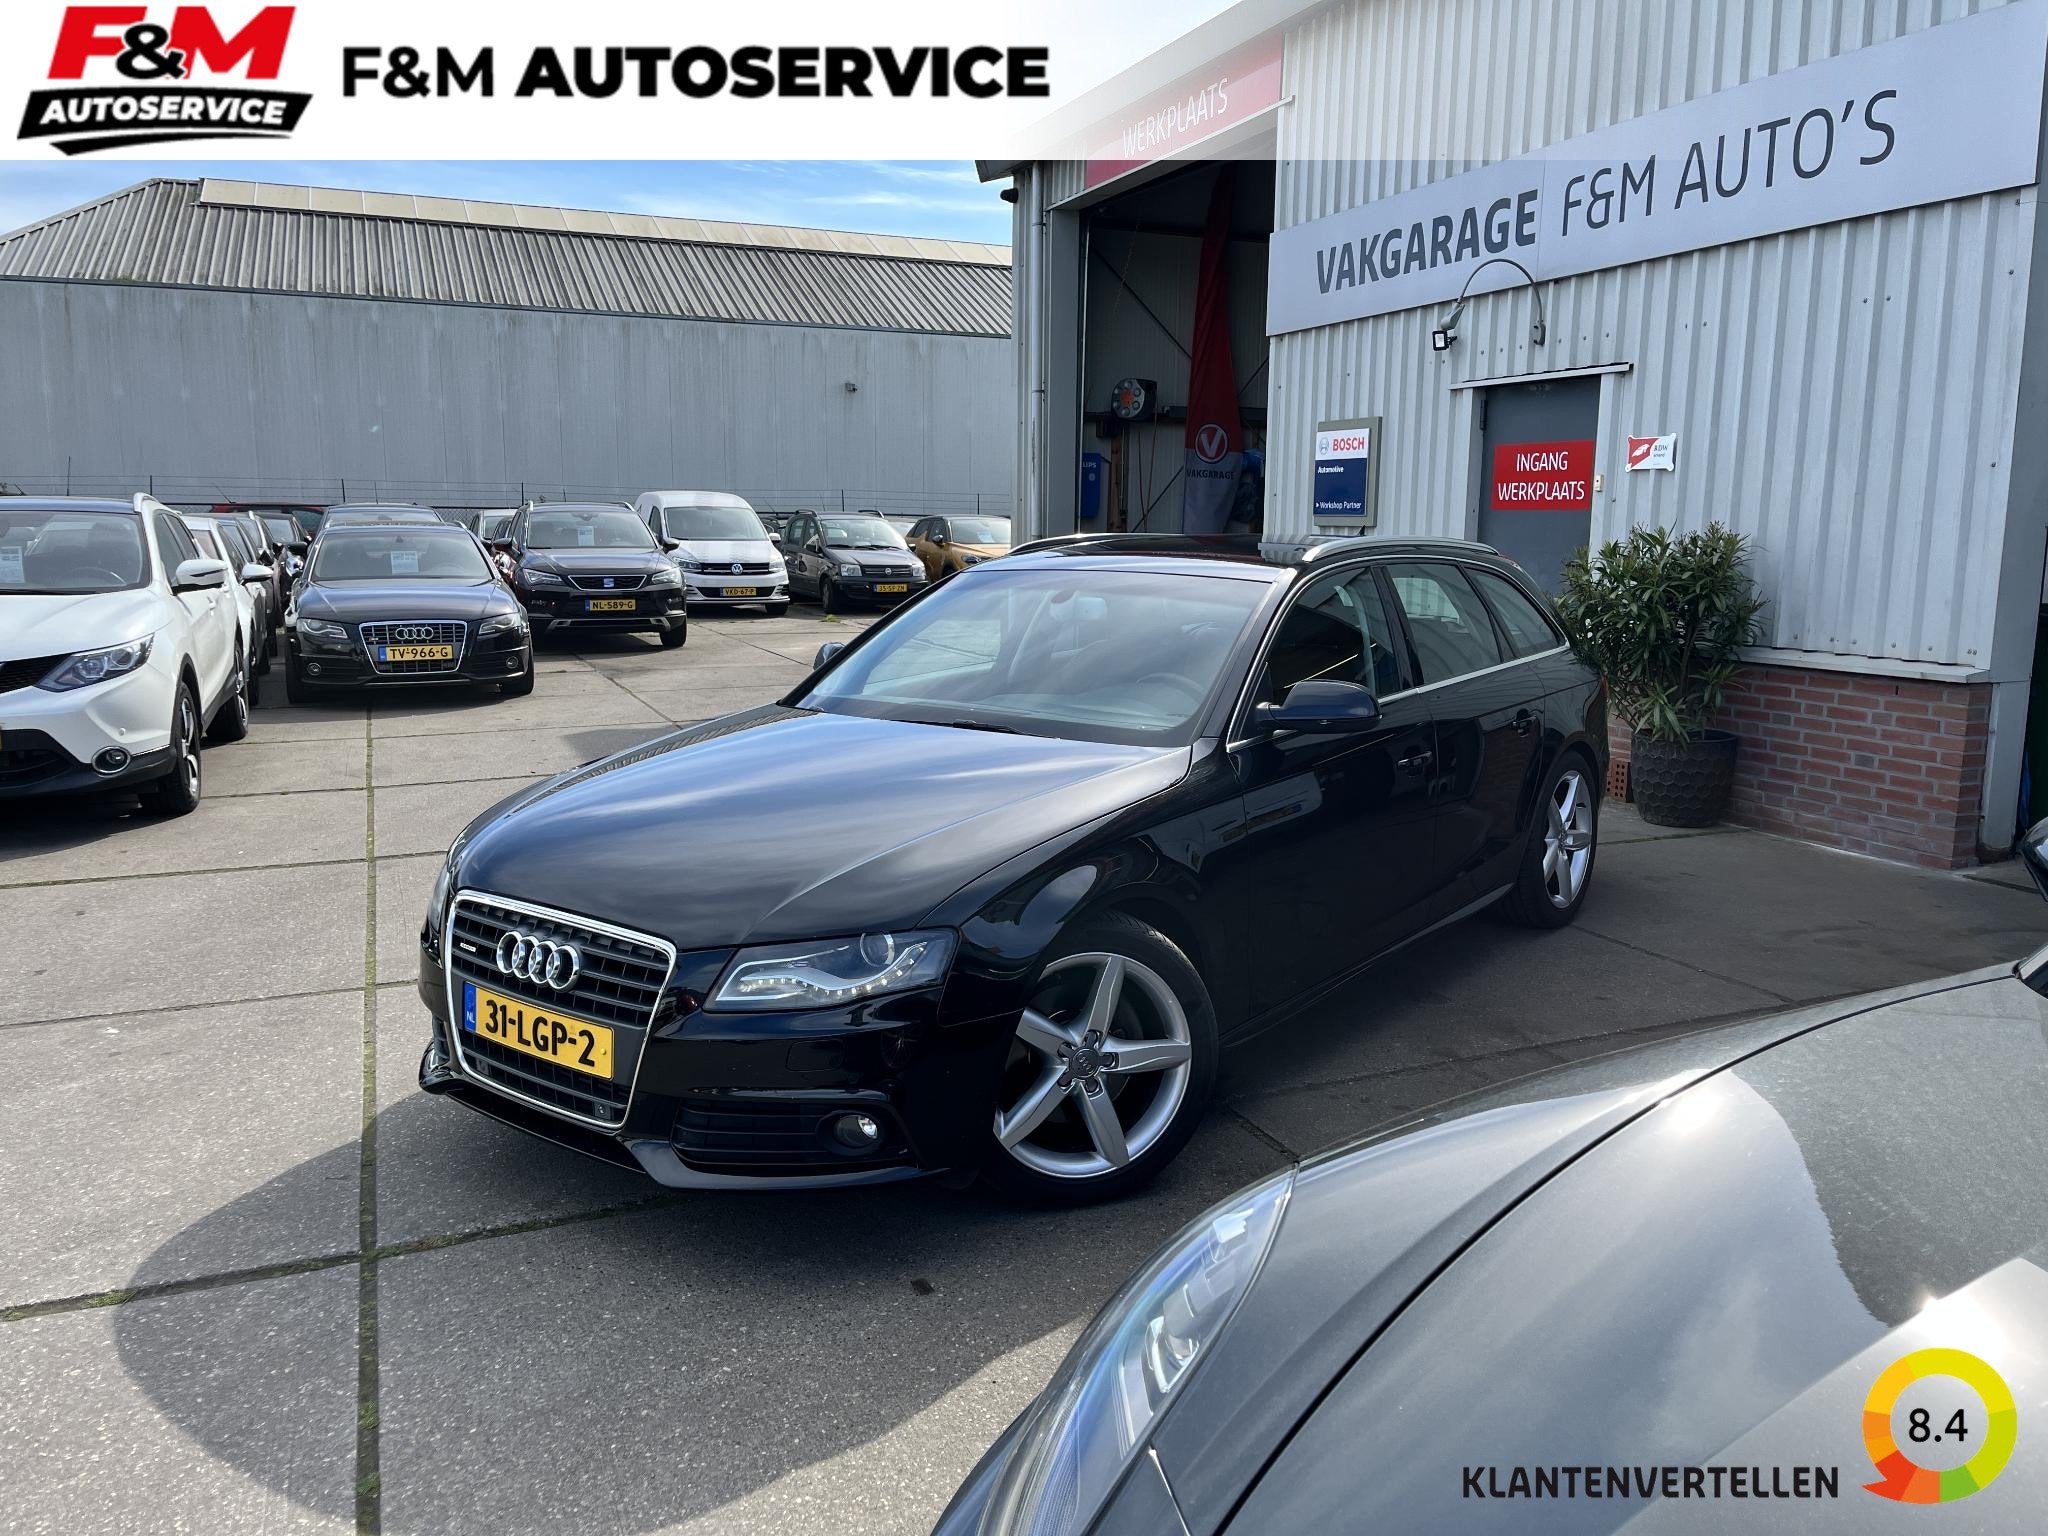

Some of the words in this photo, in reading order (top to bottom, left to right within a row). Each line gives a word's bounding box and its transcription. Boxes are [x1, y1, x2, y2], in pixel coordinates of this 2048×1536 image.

[1122, 77, 1228, 158] WERKPLAATS
[1316, 189, 1538, 294] VAKGARAGE
[1562, 154, 1656, 236] F&M
[1674, 89, 1897, 210] AUTO'S
[1332, 437, 1365, 451] BOSCH
[1516, 451, 1568, 472] INGANG
[1186, 469, 1234, 480] VAKGARAGE
[1498, 481, 1585, 501] WERKPLAATS
[1320, 502, 1343, 510] Workshop
[592, 601, 633, 609] NL-589-G
[390, 647, 449, 659] TV-966-G
[485, 999, 595, 1068] 31-LGP-2
